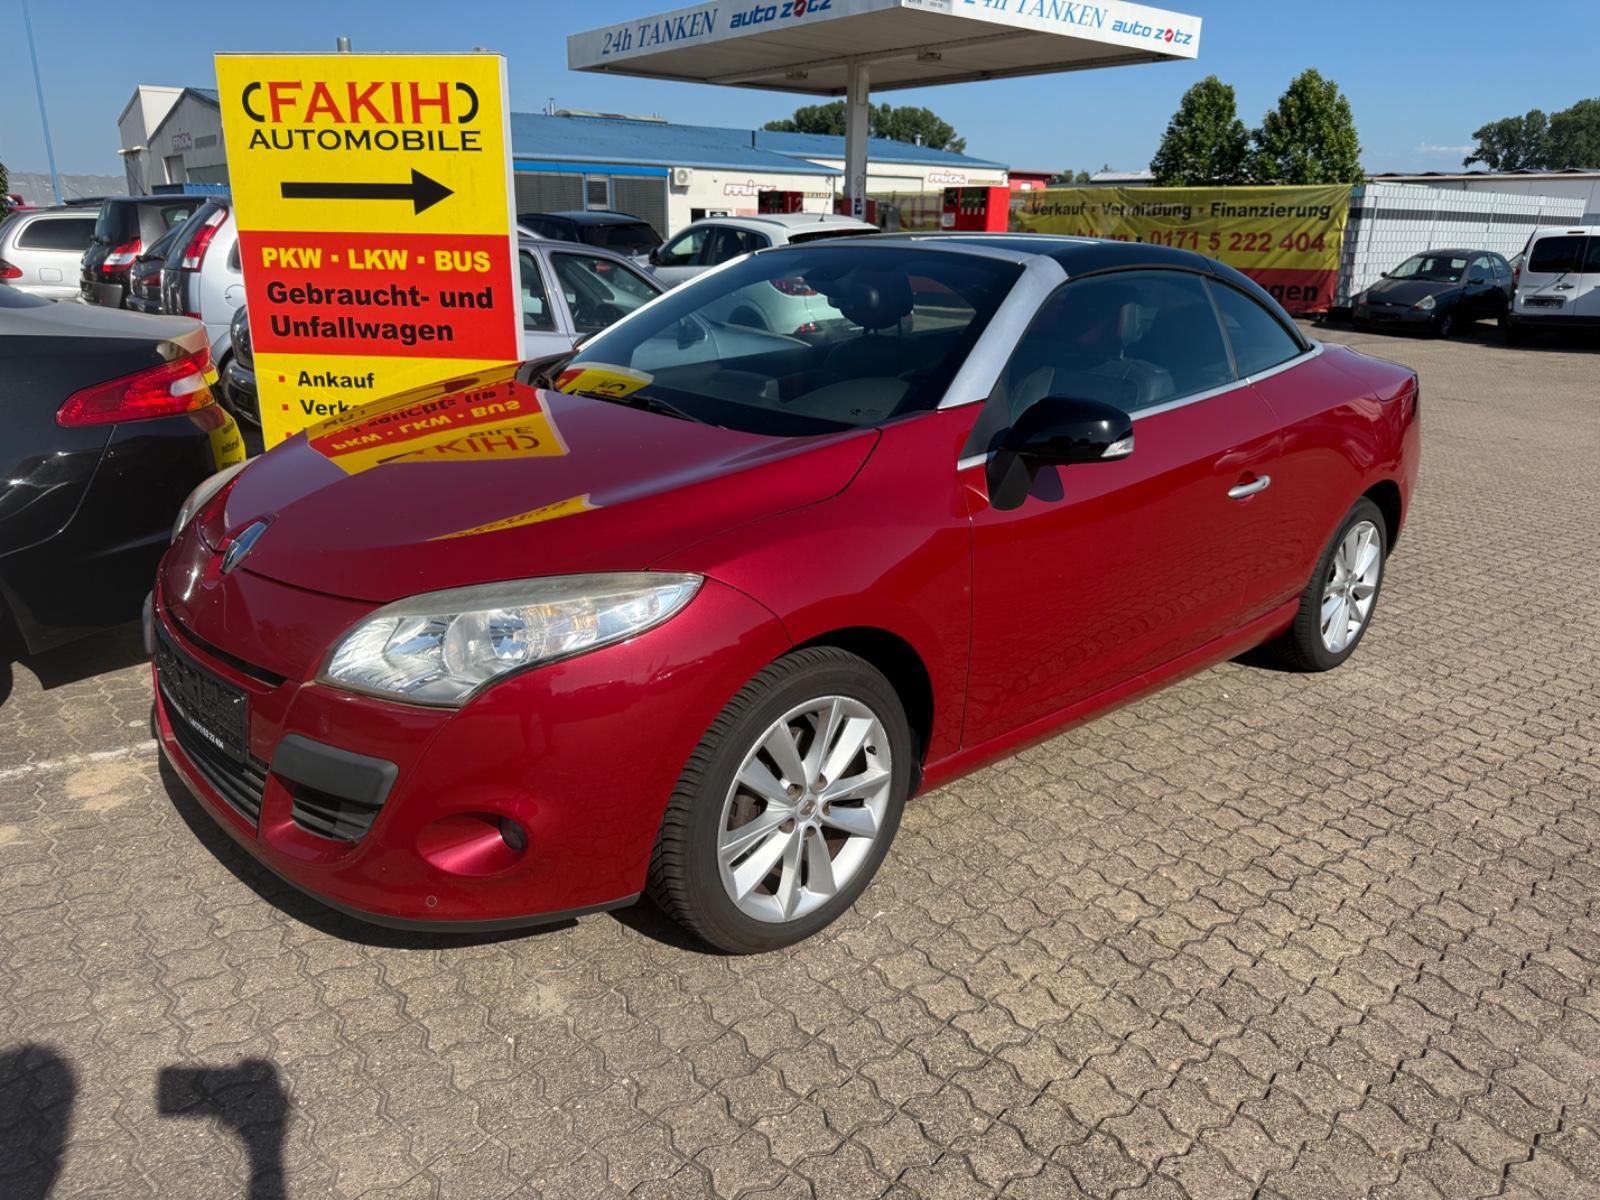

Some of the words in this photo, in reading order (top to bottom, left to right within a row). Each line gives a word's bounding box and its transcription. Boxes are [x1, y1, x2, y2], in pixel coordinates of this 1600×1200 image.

[602, 26, 632, 55] 24h
[638, 8, 719, 47] TANKEN
[730, 5, 775, 29] auto
[1113, 20, 1152, 38] auto
[267, 81, 452, 124] FAKIH
[248, 129, 482, 151] AUTOMOBILE
[1032, 202, 1085, 216] Verkauf
[1210, 202, 1332, 220] Finanzierung
[1150, 231, 1199, 250] 0171
[1208, 232, 1221, 251] 5
[1228, 232, 1272, 251] 222
[1279, 232, 1325, 252] 404
[261, 247, 321, 269] PKW
[347, 249, 408, 270] LKW
[434, 251, 491, 272] BUS
[266, 281, 430, 307] Gebraucht-
[439, 287, 494, 309] und
[1267, 283, 1319, 303] gen
[271, 315, 454, 345] Unfallwagen
[298, 371, 375, 389] Ankauf
[300, 400, 358, 416] Verk
